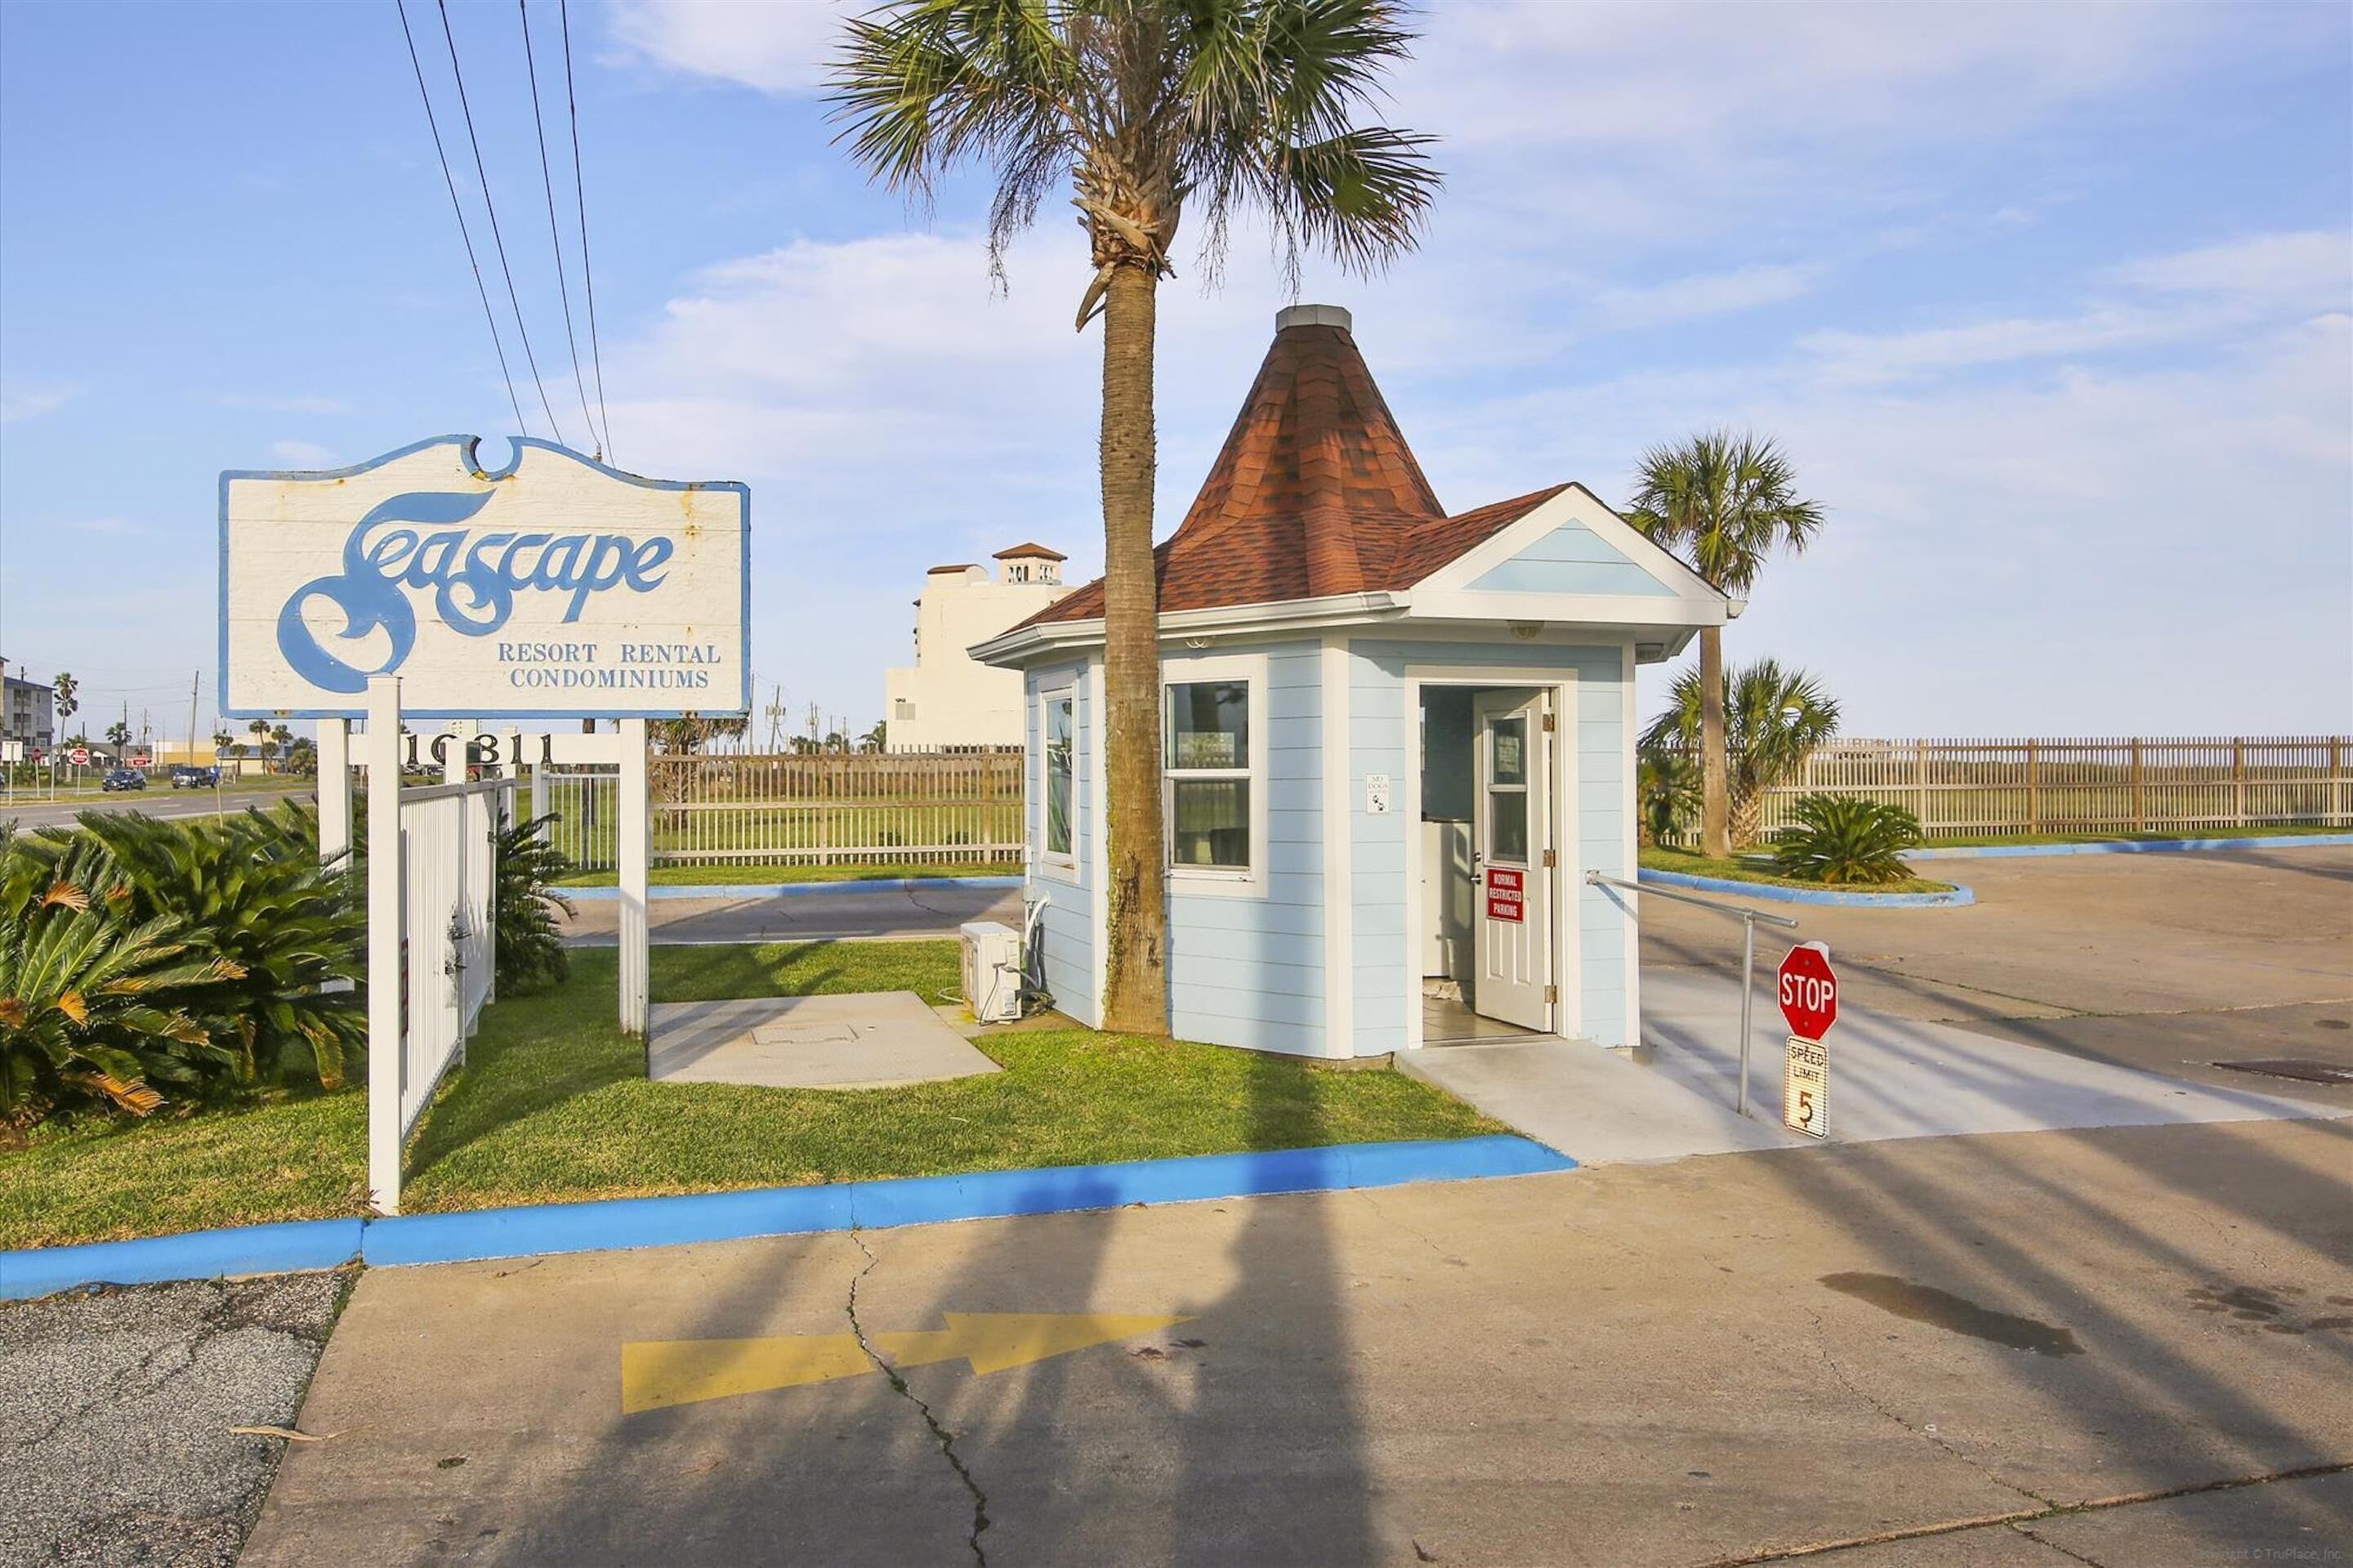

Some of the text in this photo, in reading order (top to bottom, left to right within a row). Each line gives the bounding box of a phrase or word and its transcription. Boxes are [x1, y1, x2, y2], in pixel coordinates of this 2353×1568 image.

[498, 643, 721, 664] RESORT RENTAL
[511, 668, 709, 689] CONDOMINIUMS
[1489, 887, 1521, 902] RESTRICTED
[1494, 903, 1517, 917] PARKING
[1782, 972, 1833, 1013] STOP
[1791, 1047, 1824, 1065] SPEED
[1793, 1065, 1819, 1083] LIMIT
[1800, 1091, 1813, 1123] 5
